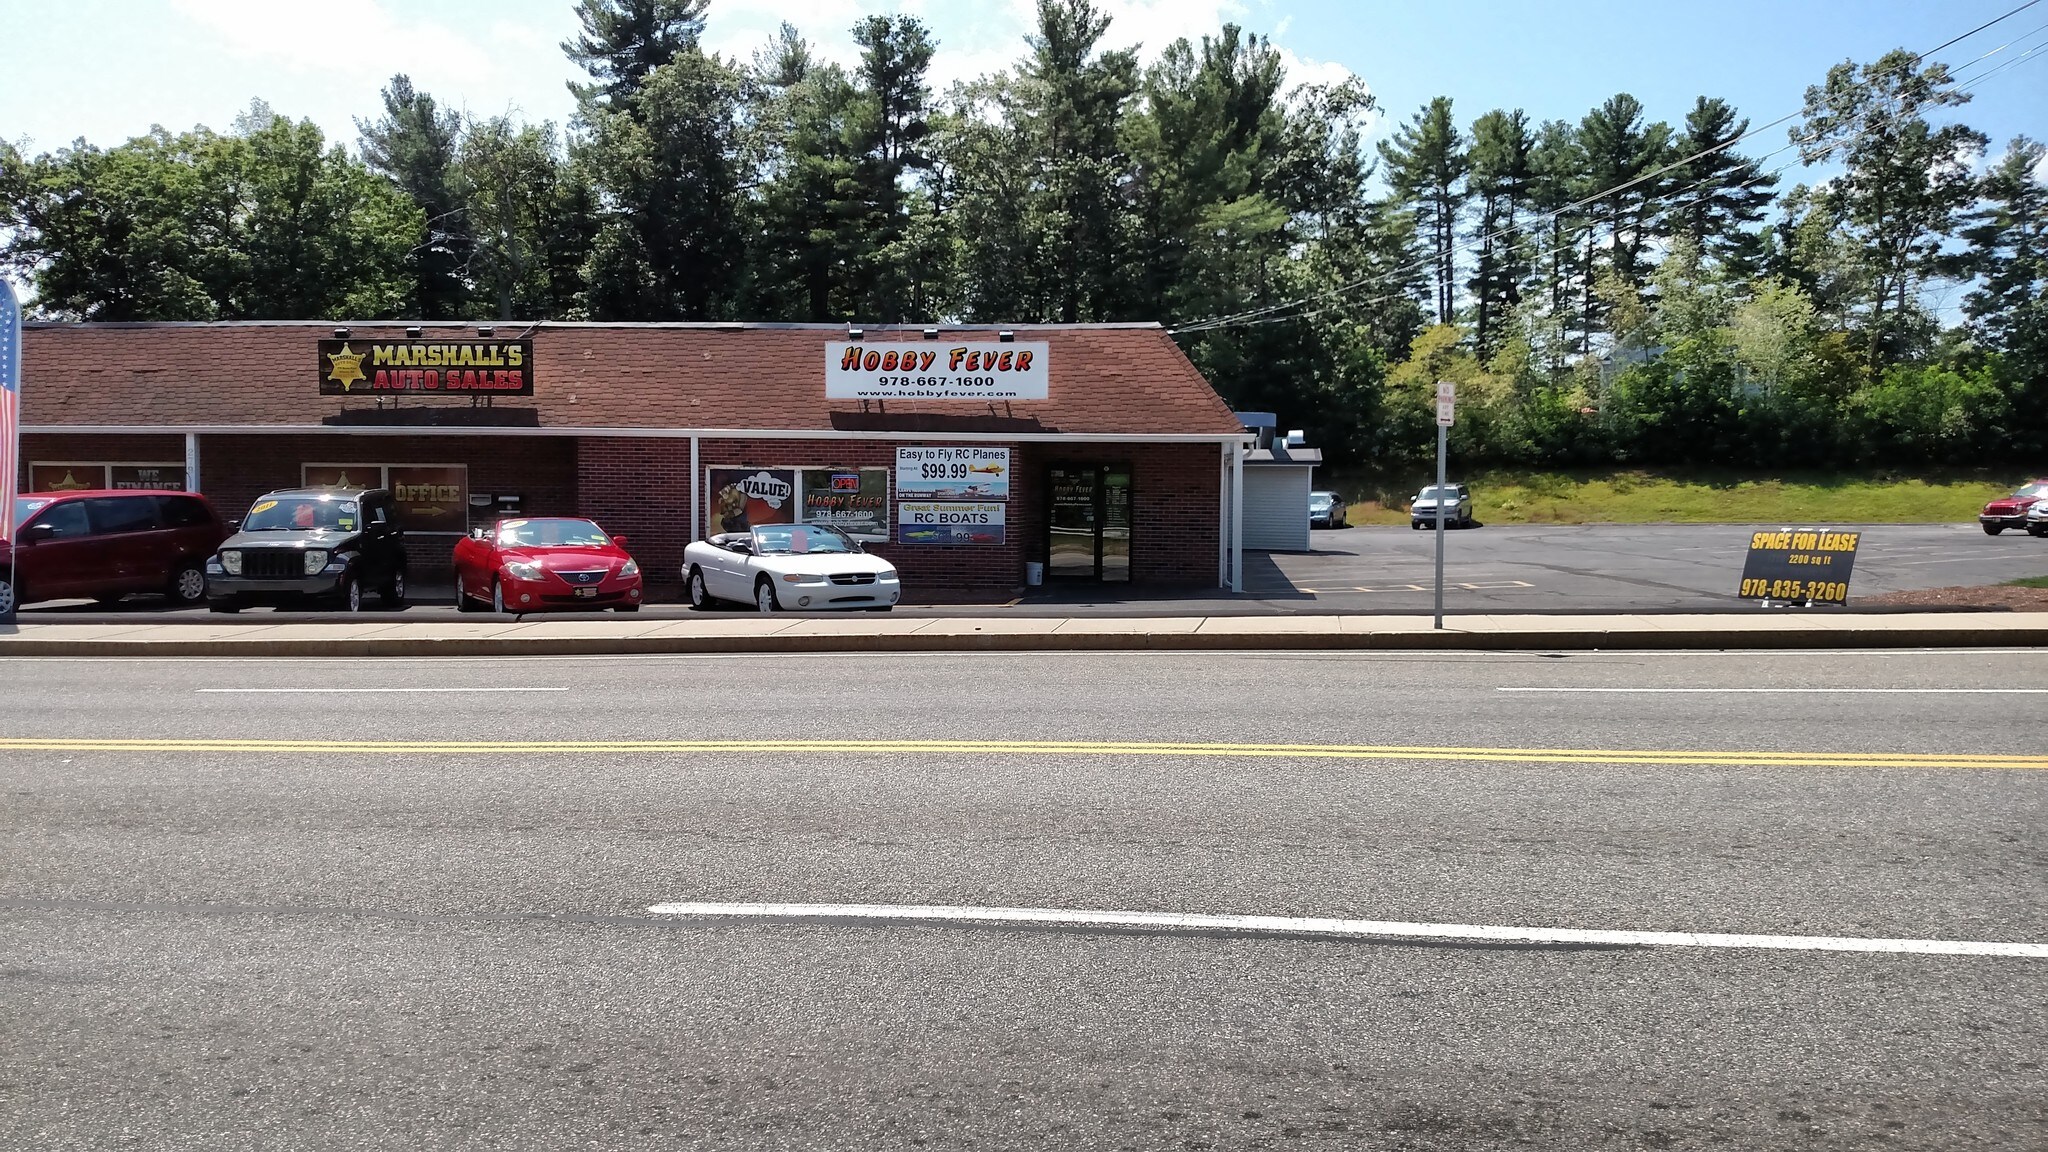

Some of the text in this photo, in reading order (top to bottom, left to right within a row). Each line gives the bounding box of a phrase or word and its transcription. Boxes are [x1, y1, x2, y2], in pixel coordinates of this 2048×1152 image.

[372, 345, 523, 366] MARSHALL'S
[841, 346, 1034, 372] HOBBY FEVER
[373, 370, 523, 389] AUTO SALES
[879, 376, 995, 387] 978-667-1600
[857, 389, 1017, 398] www.hobbyfever.com
[900, 449, 1006, 461] Easy to Fly RC Planes
[138, 469, 160, 481] WE
[921, 463, 967, 480] $99.99
[116, 481, 181, 490] FINANCE
[743, 480, 789, 497] VALUE!
[833, 478, 857, 489] OPEN
[395, 485, 460, 502] OFFICE
[807, 494, 883, 508] HOBBY FEVER
[816, 510, 874, 518] 978-667-1600
[903, 504, 1000, 512] Great Summer Fun!
[914, 513, 988, 523] RC BOATS
[1751, 532, 1858, 552] SPACE FOR LEASE
[1789, 554, 1832, 565] 2200 sq ft
[1741, 578, 1847, 601] 978-835-3260
